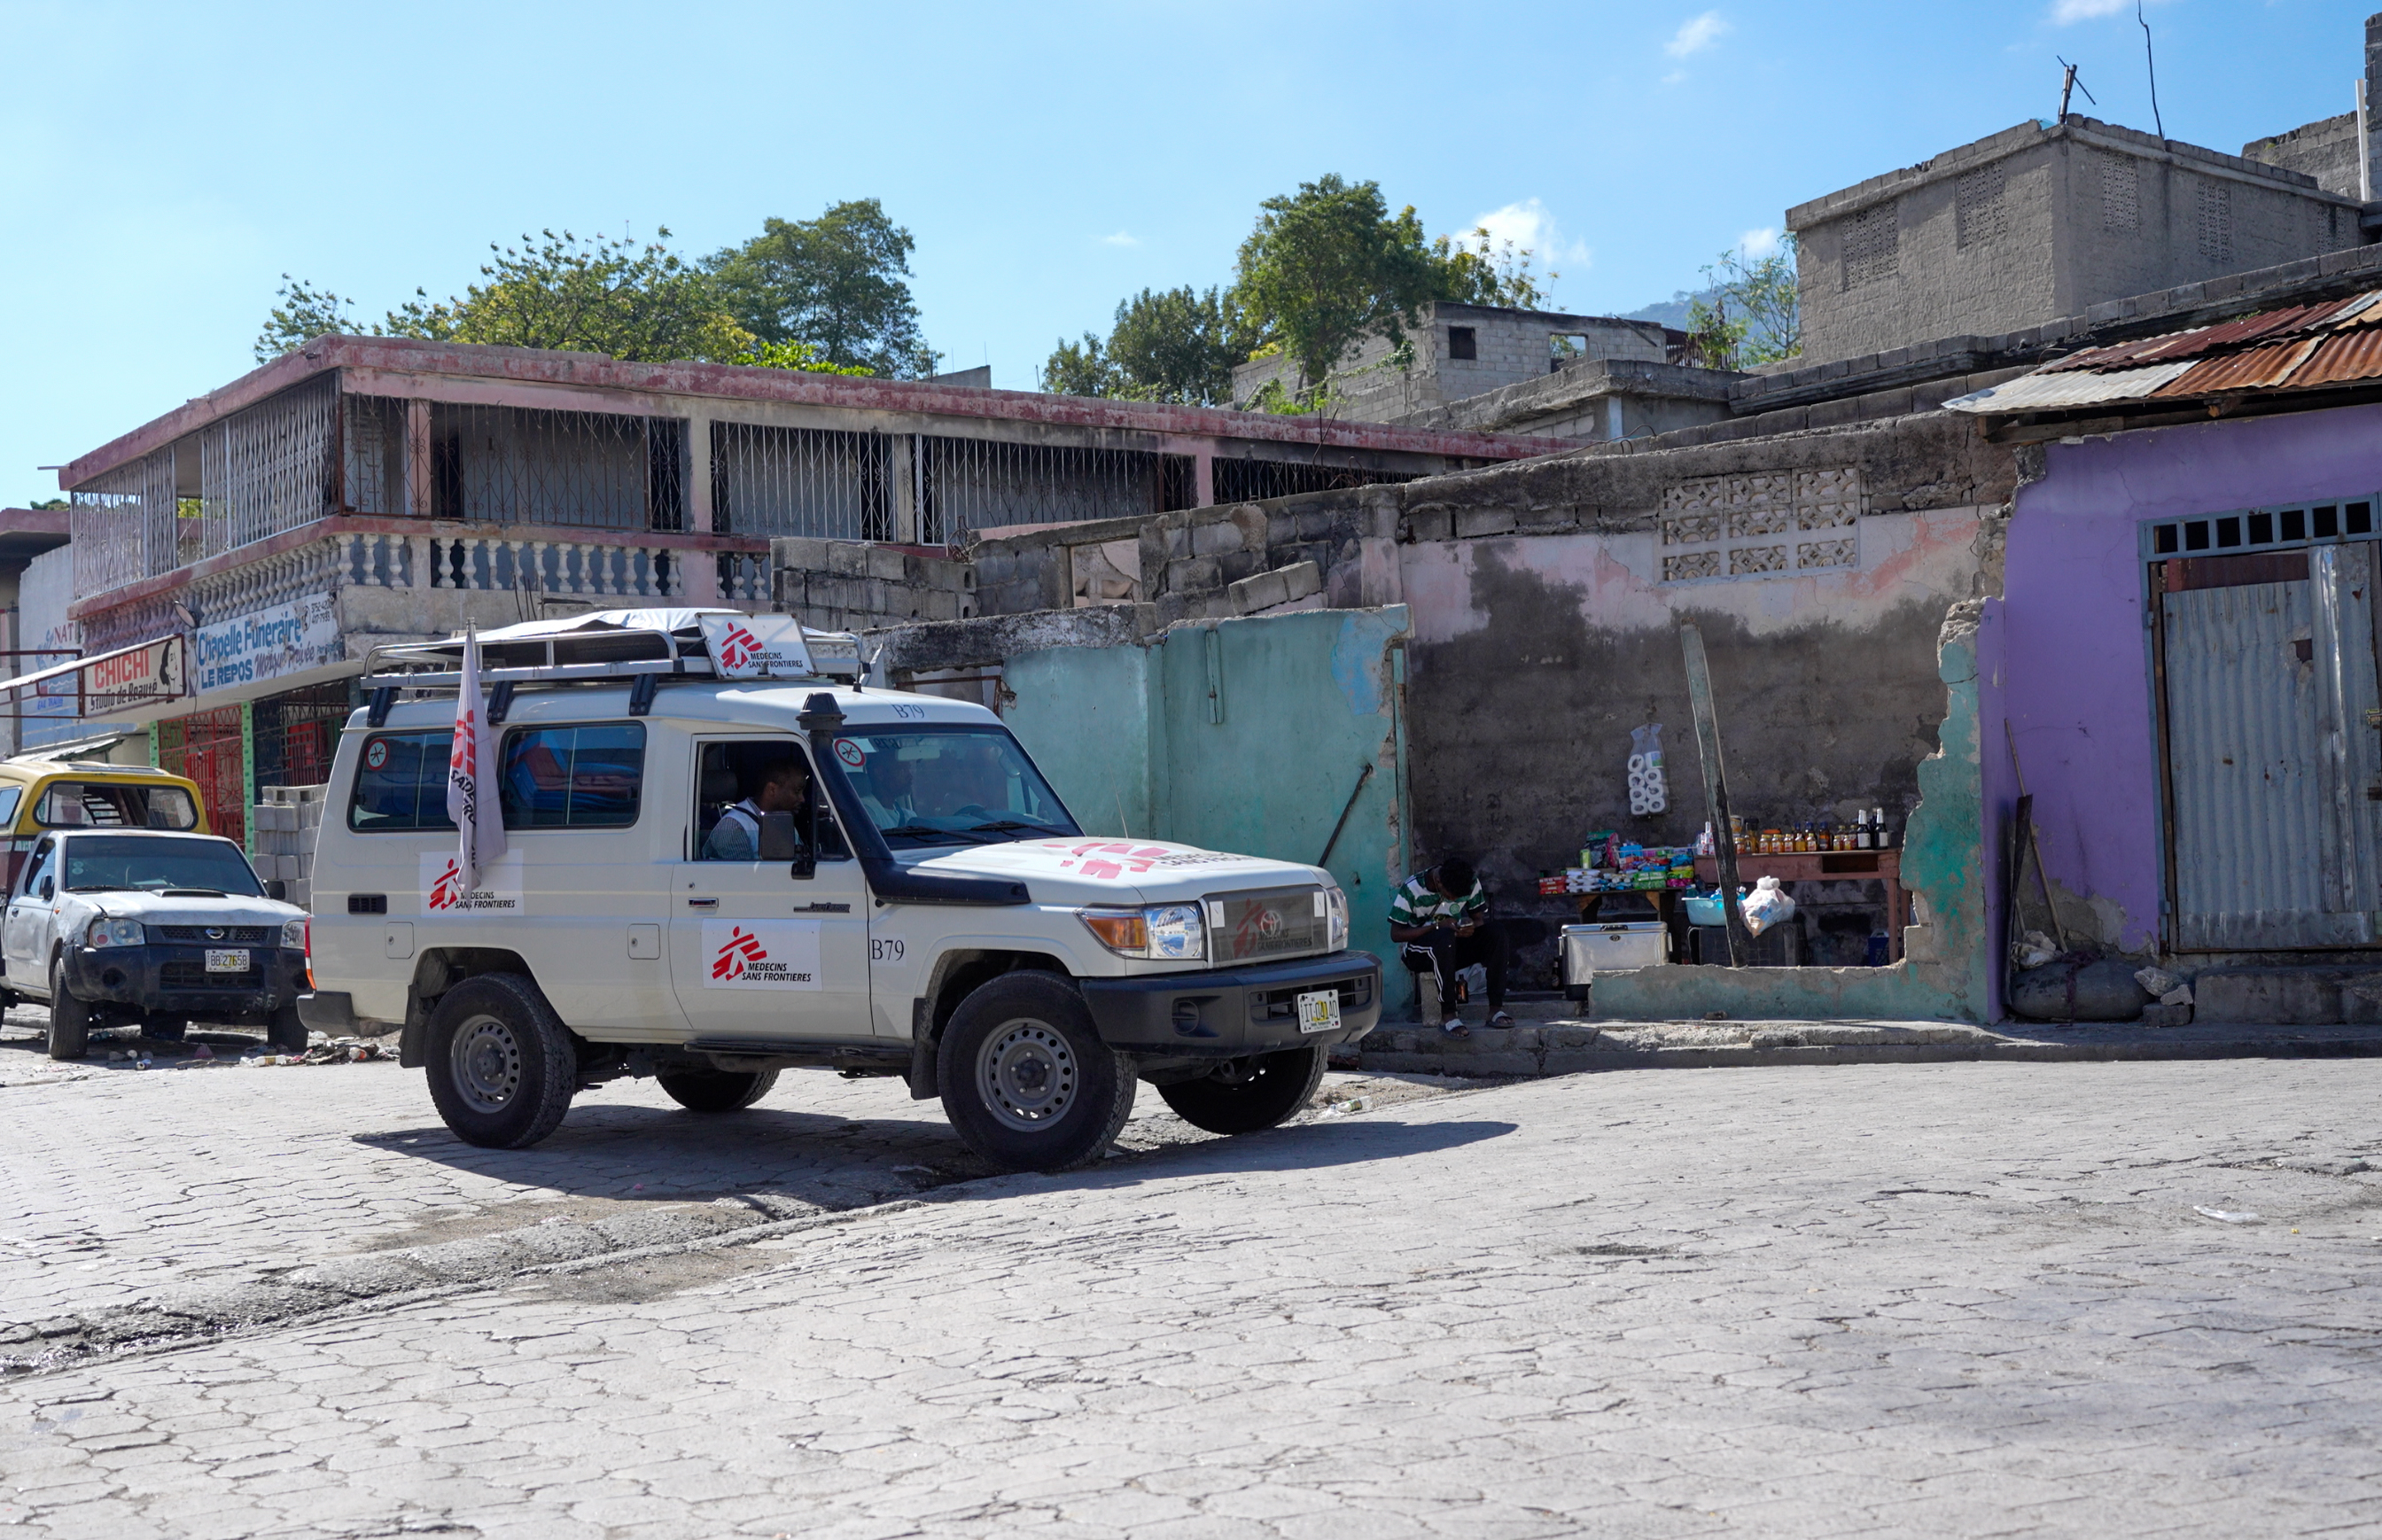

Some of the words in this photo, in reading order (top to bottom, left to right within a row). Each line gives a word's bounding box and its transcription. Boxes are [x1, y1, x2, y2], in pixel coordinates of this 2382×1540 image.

[198, 624, 243, 666] Chapelle
[94, 649, 150, 689] CHICHI
[201, 669, 215, 689] LE
[217, 658, 253, 686] REPOS
[90, 688, 115, 712] Studio
[116, 686, 127, 705] de
[128, 678, 158, 703] Beauté
[891, 704, 924, 719] B79
[461, 891, 494, 899] MDECINS
[474, 899, 516, 909] FRONTIERES
[871, 939, 905, 961] B79
[748, 962, 787, 972] MEDECINS
[742, 972, 762, 981] SANS
[763, 973, 812, 983] FRONTIERES
